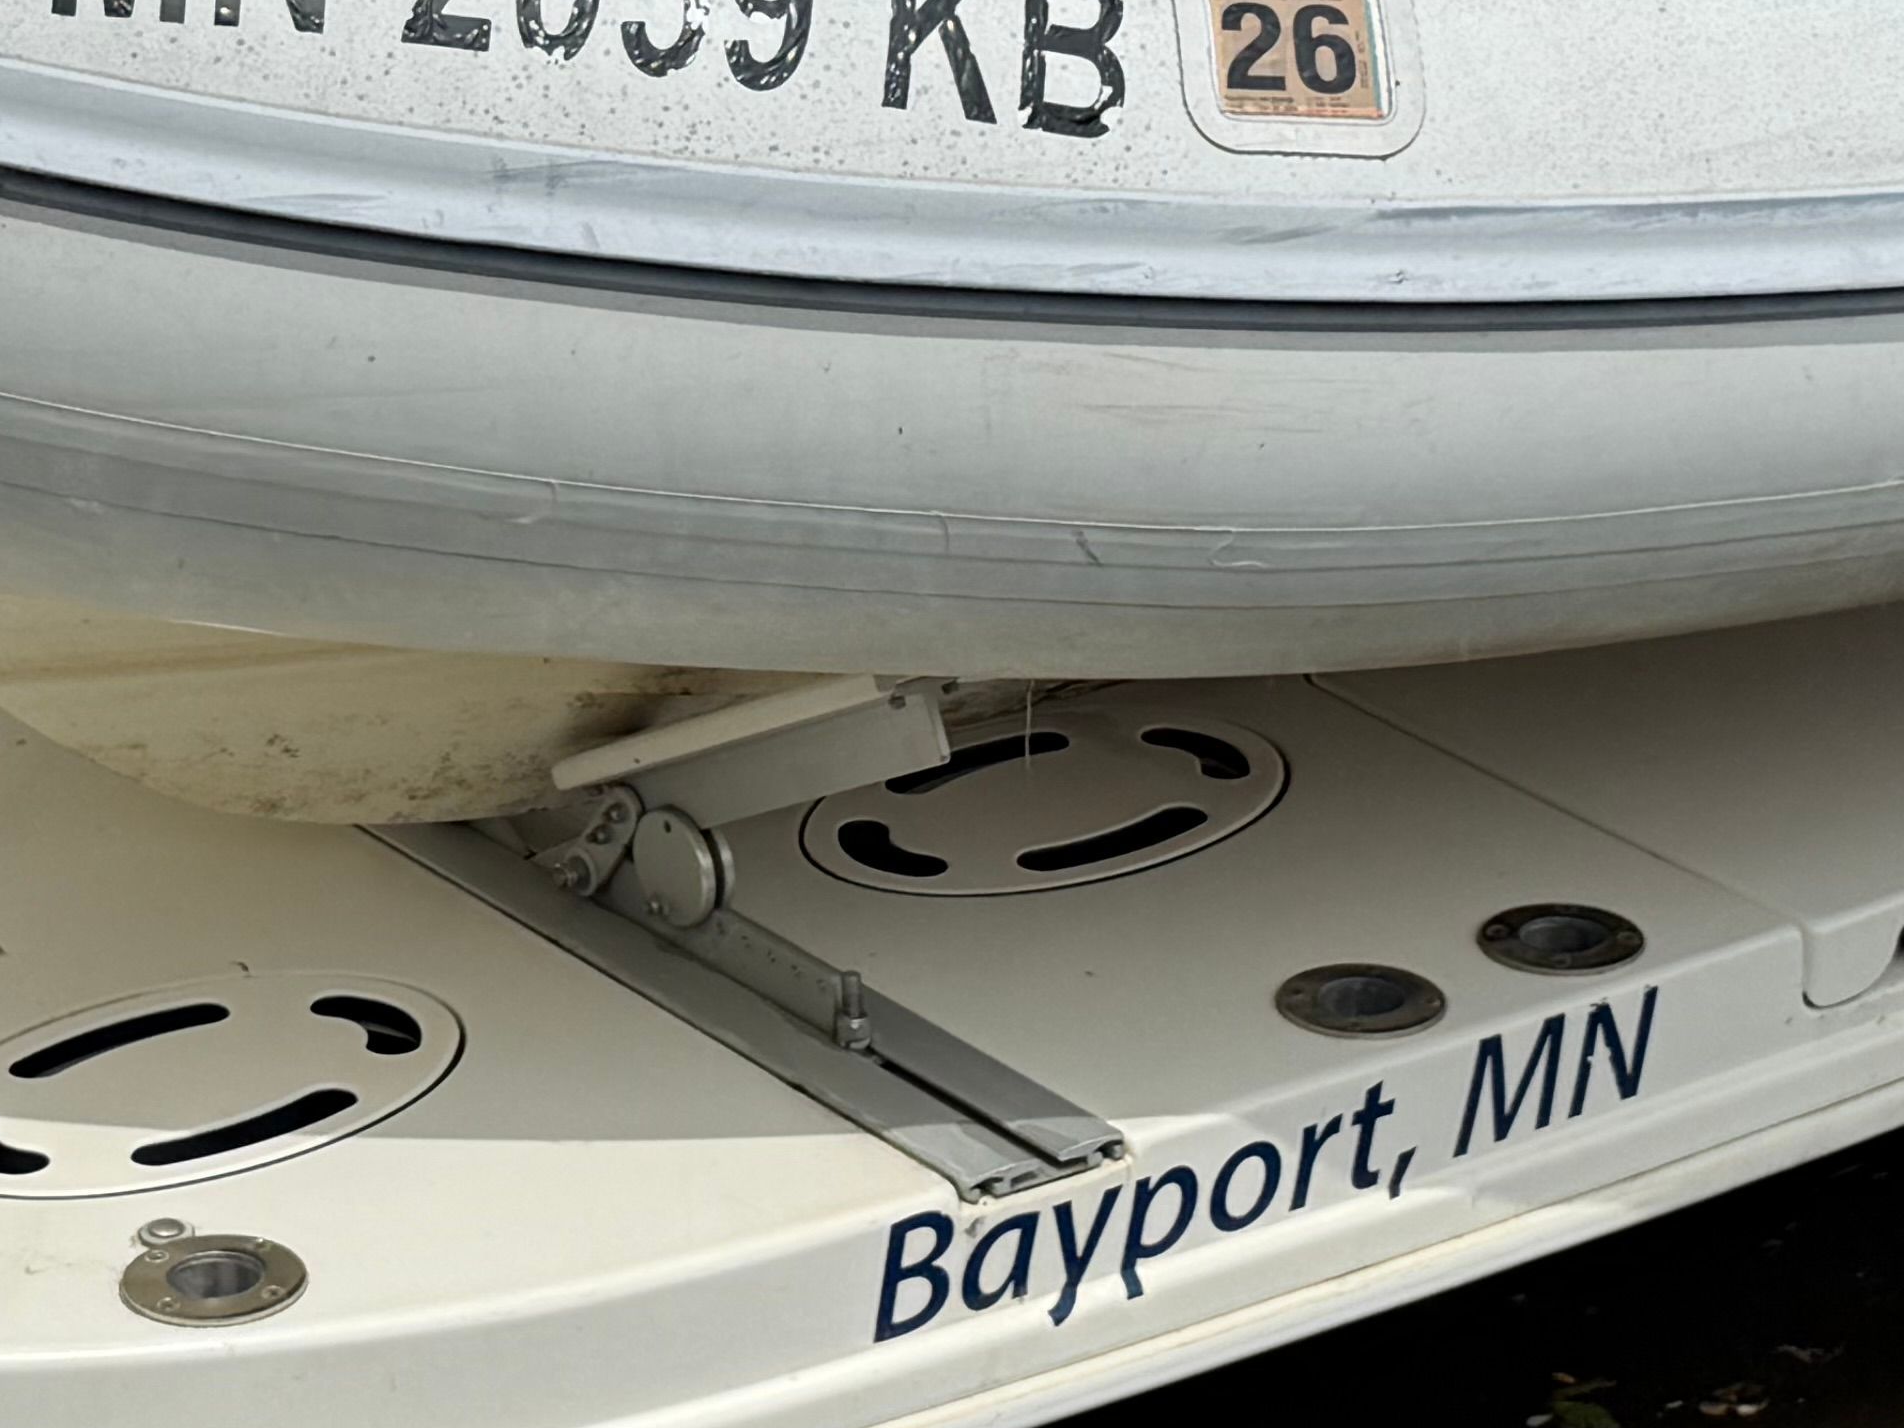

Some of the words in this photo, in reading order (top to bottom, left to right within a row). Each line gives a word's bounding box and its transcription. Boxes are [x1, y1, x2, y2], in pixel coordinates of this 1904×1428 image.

[1221, 1, 1357, 95] 26
[873, 1079, 1417, 1344] Bayport,
[1452, 984, 1659, 1160] MN
